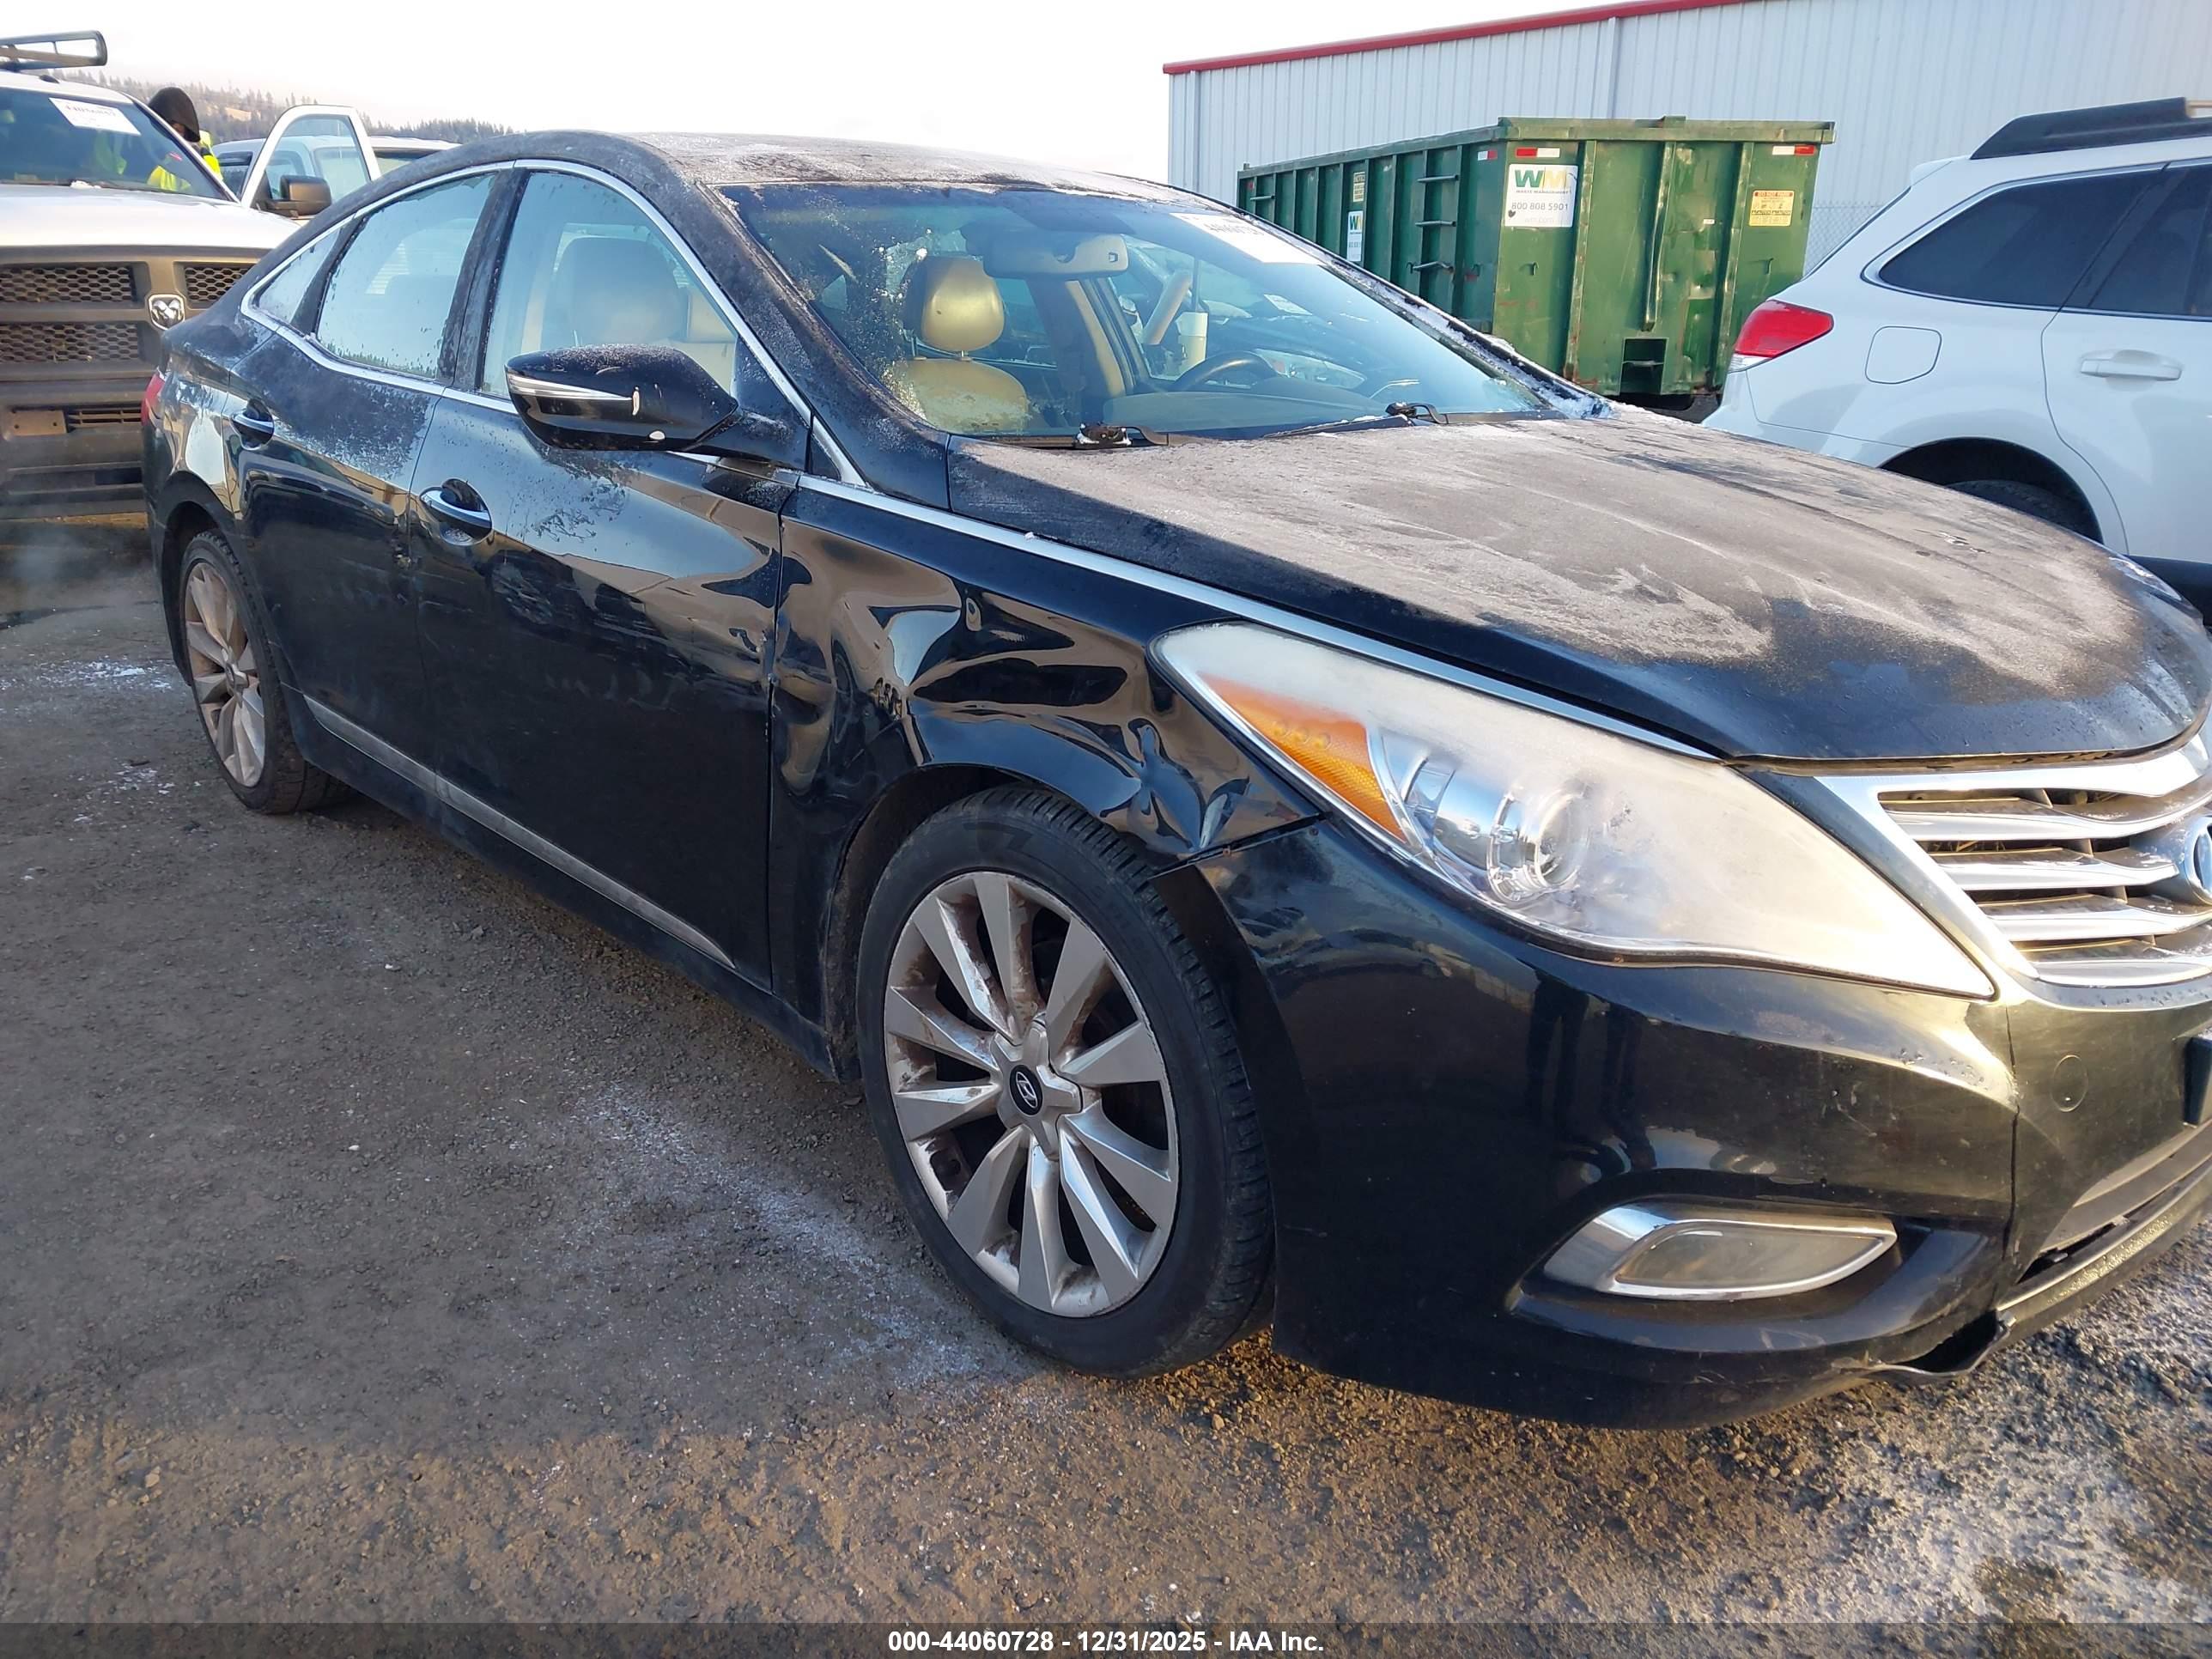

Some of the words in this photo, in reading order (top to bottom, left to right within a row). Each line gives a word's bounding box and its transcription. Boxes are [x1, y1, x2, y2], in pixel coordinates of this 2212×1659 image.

[1515, 169, 1566, 189] WM
[1529, 202, 1546, 210] 808
[1548, 202, 1569, 210] 5901
